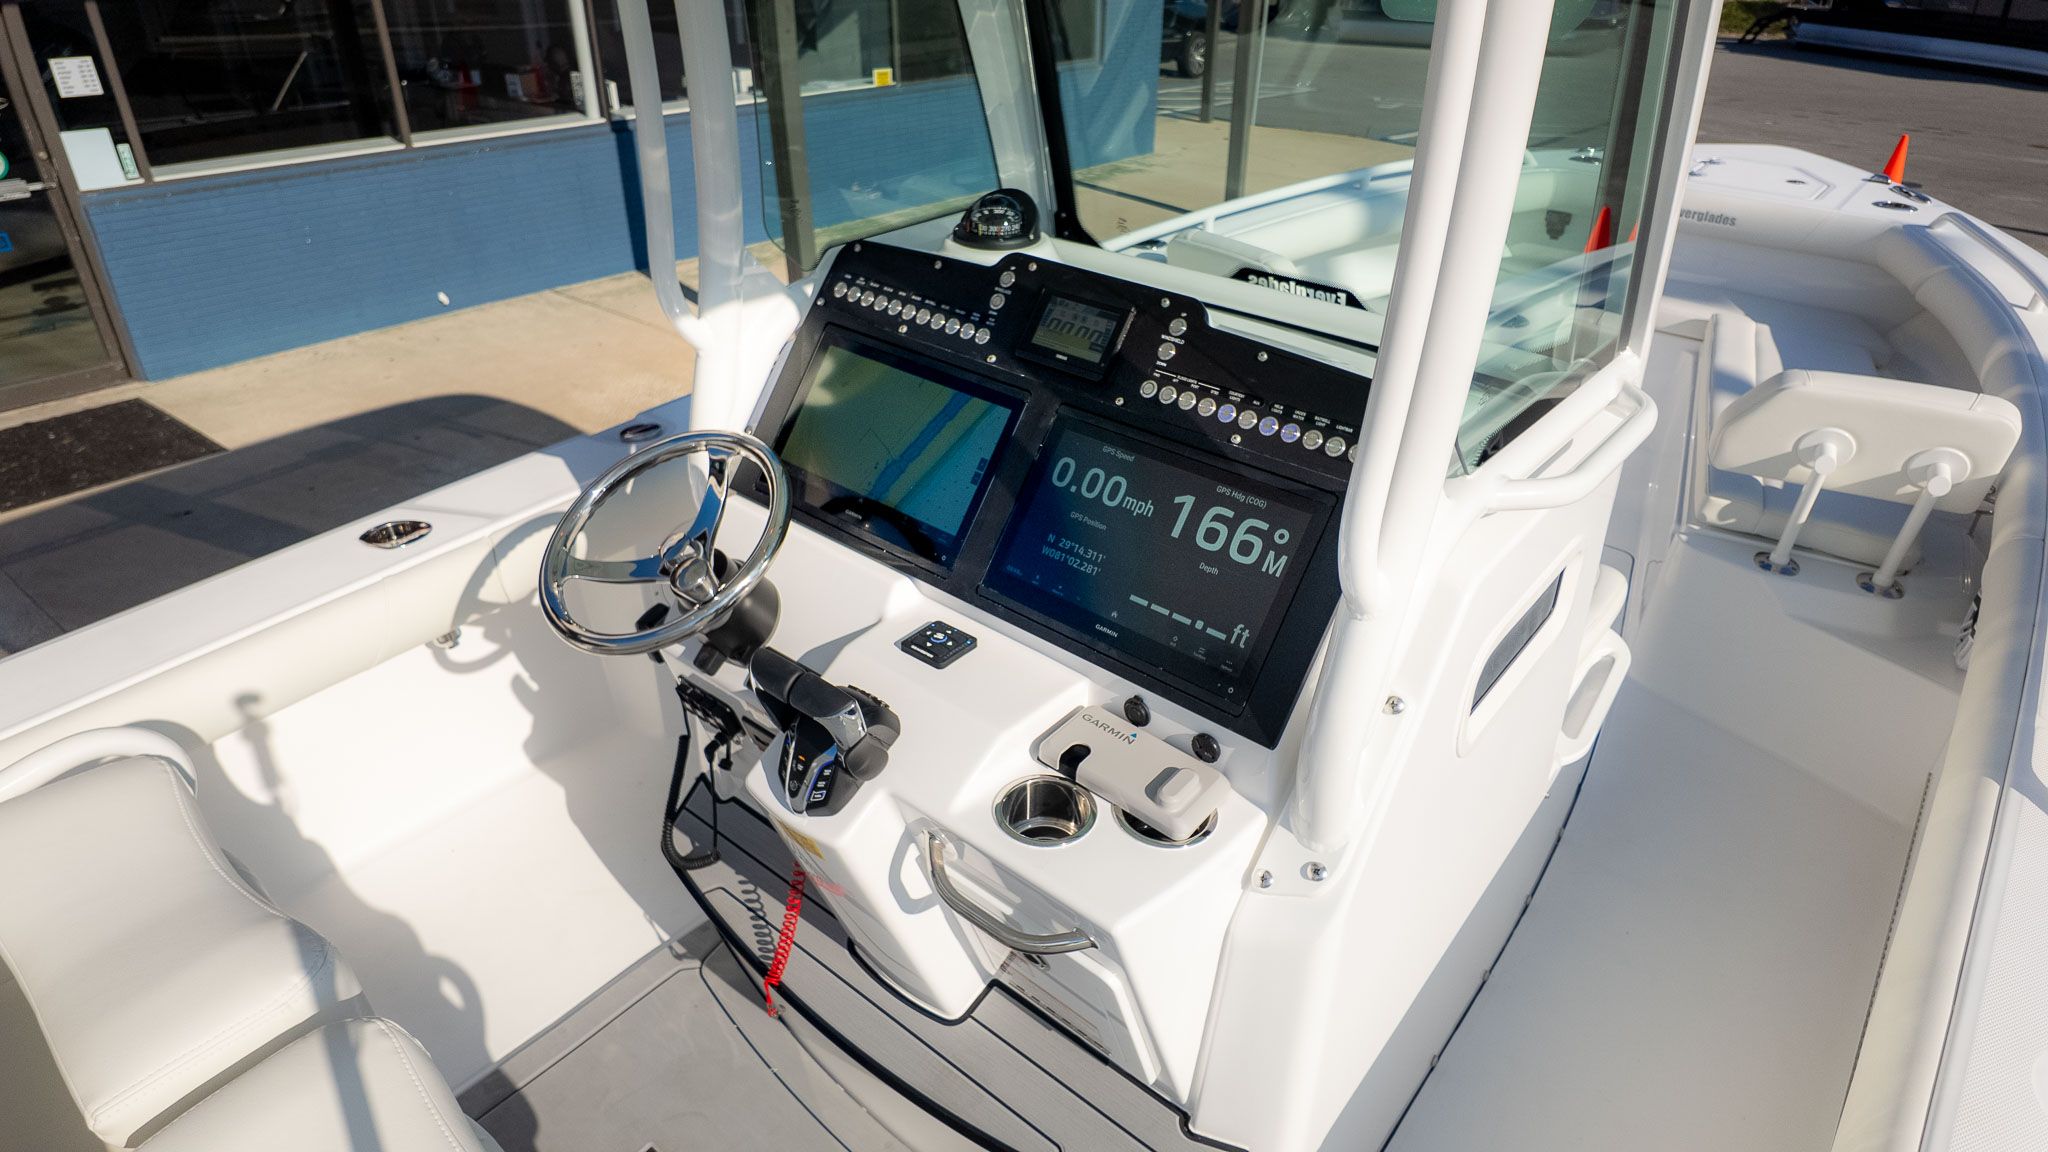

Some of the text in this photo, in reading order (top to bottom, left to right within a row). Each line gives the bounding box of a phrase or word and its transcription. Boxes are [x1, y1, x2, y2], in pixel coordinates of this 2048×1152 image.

[1680, 208, 1737, 227] verglades
[1102, 445, 1135, 462] GPS Speed
[1052, 456, 1154, 518] 0.00 mph
[1216, 485, 1267, 510] GPS Hdg (COG)
[1070, 511, 1107, 531] GPS Position
[1047, 533, 1056, 543] N
[1199, 561, 1219, 576] Depth
[1261, 550, 1288, 578] M
[1095, 623, 1119, 638] GARMIN
[1230, 623, 1250, 649] ft
[1081, 713, 1136, 745] GARMIN
